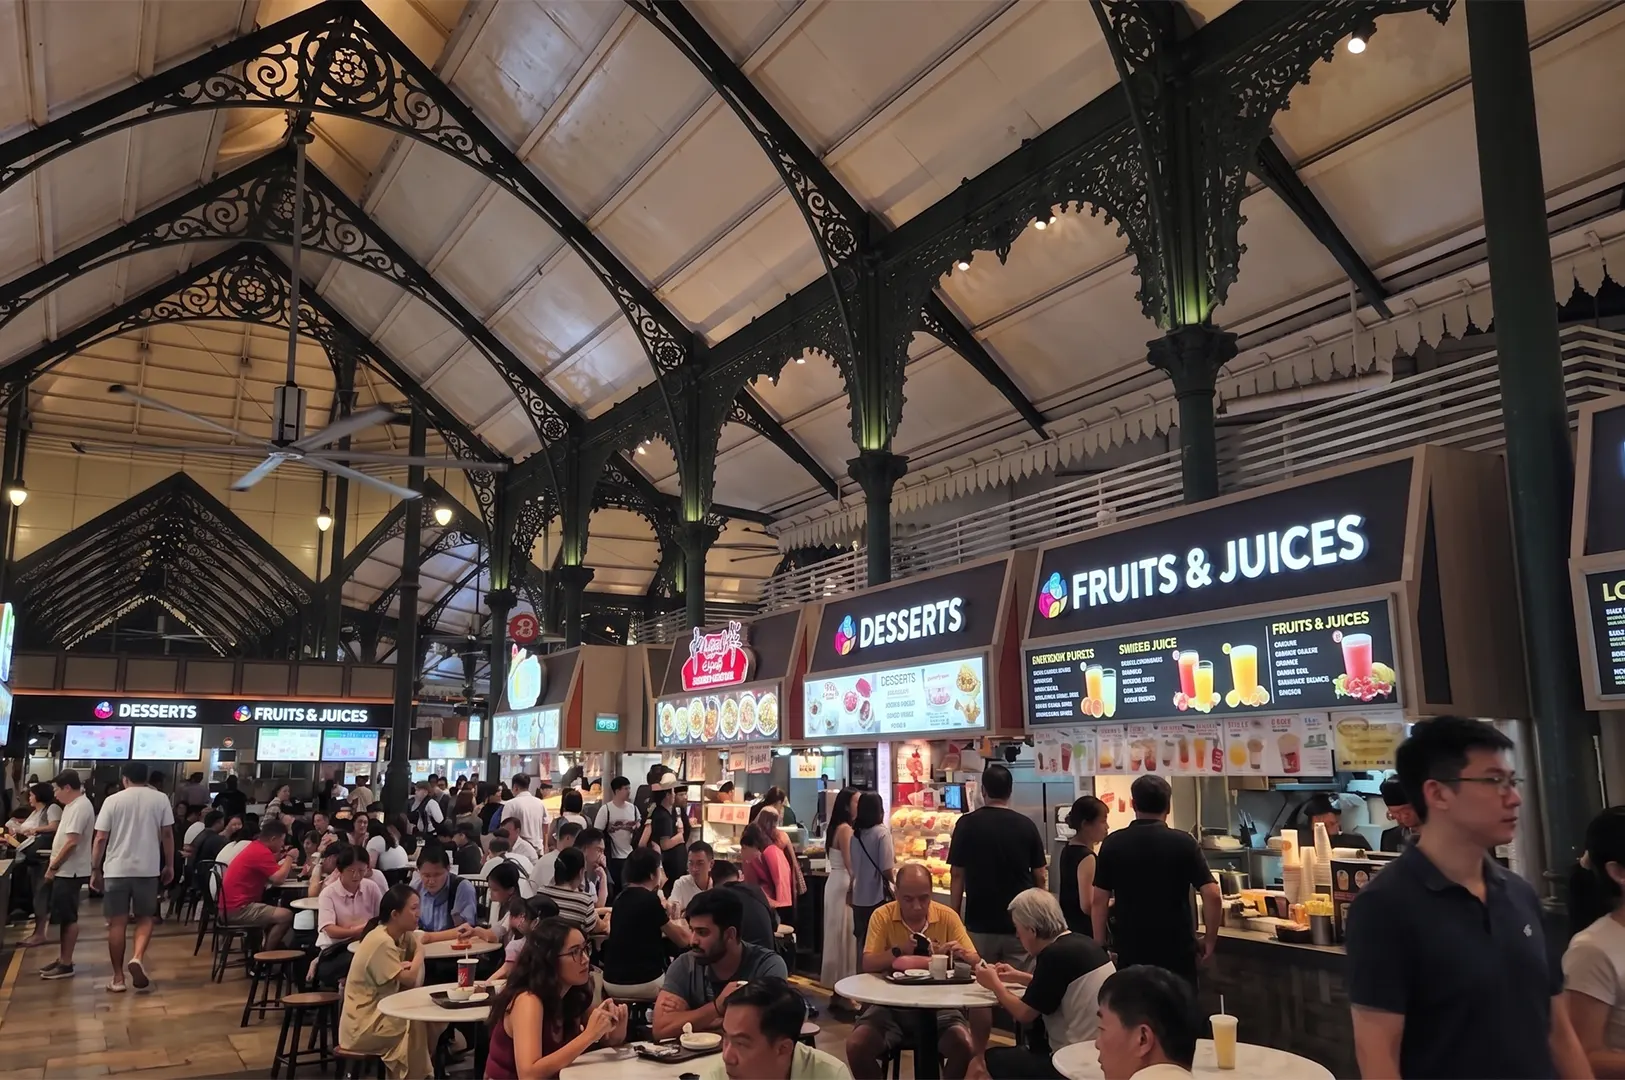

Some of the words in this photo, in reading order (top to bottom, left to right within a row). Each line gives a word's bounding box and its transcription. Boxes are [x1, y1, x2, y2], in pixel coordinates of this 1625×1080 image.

[1072, 554, 1178, 610] FRUITS
[1186, 547, 1212, 589] &
[1219, 514, 1365, 583] JUICES
[859, 597, 963, 649] DESSERTS
[1272, 619, 1313, 635] FRUITS
[1314, 618, 1324, 630] &
[1325, 611, 1370, 629] JUICES
[1151, 637, 1177, 651] JUICE
[881, 672, 916, 687] DESSERTS
[118, 703, 197, 719] DESSERTS
[254, 707, 304, 721] FRUITS
[306, 708, 318, 722] &
[319, 709, 368, 723] JUICES
